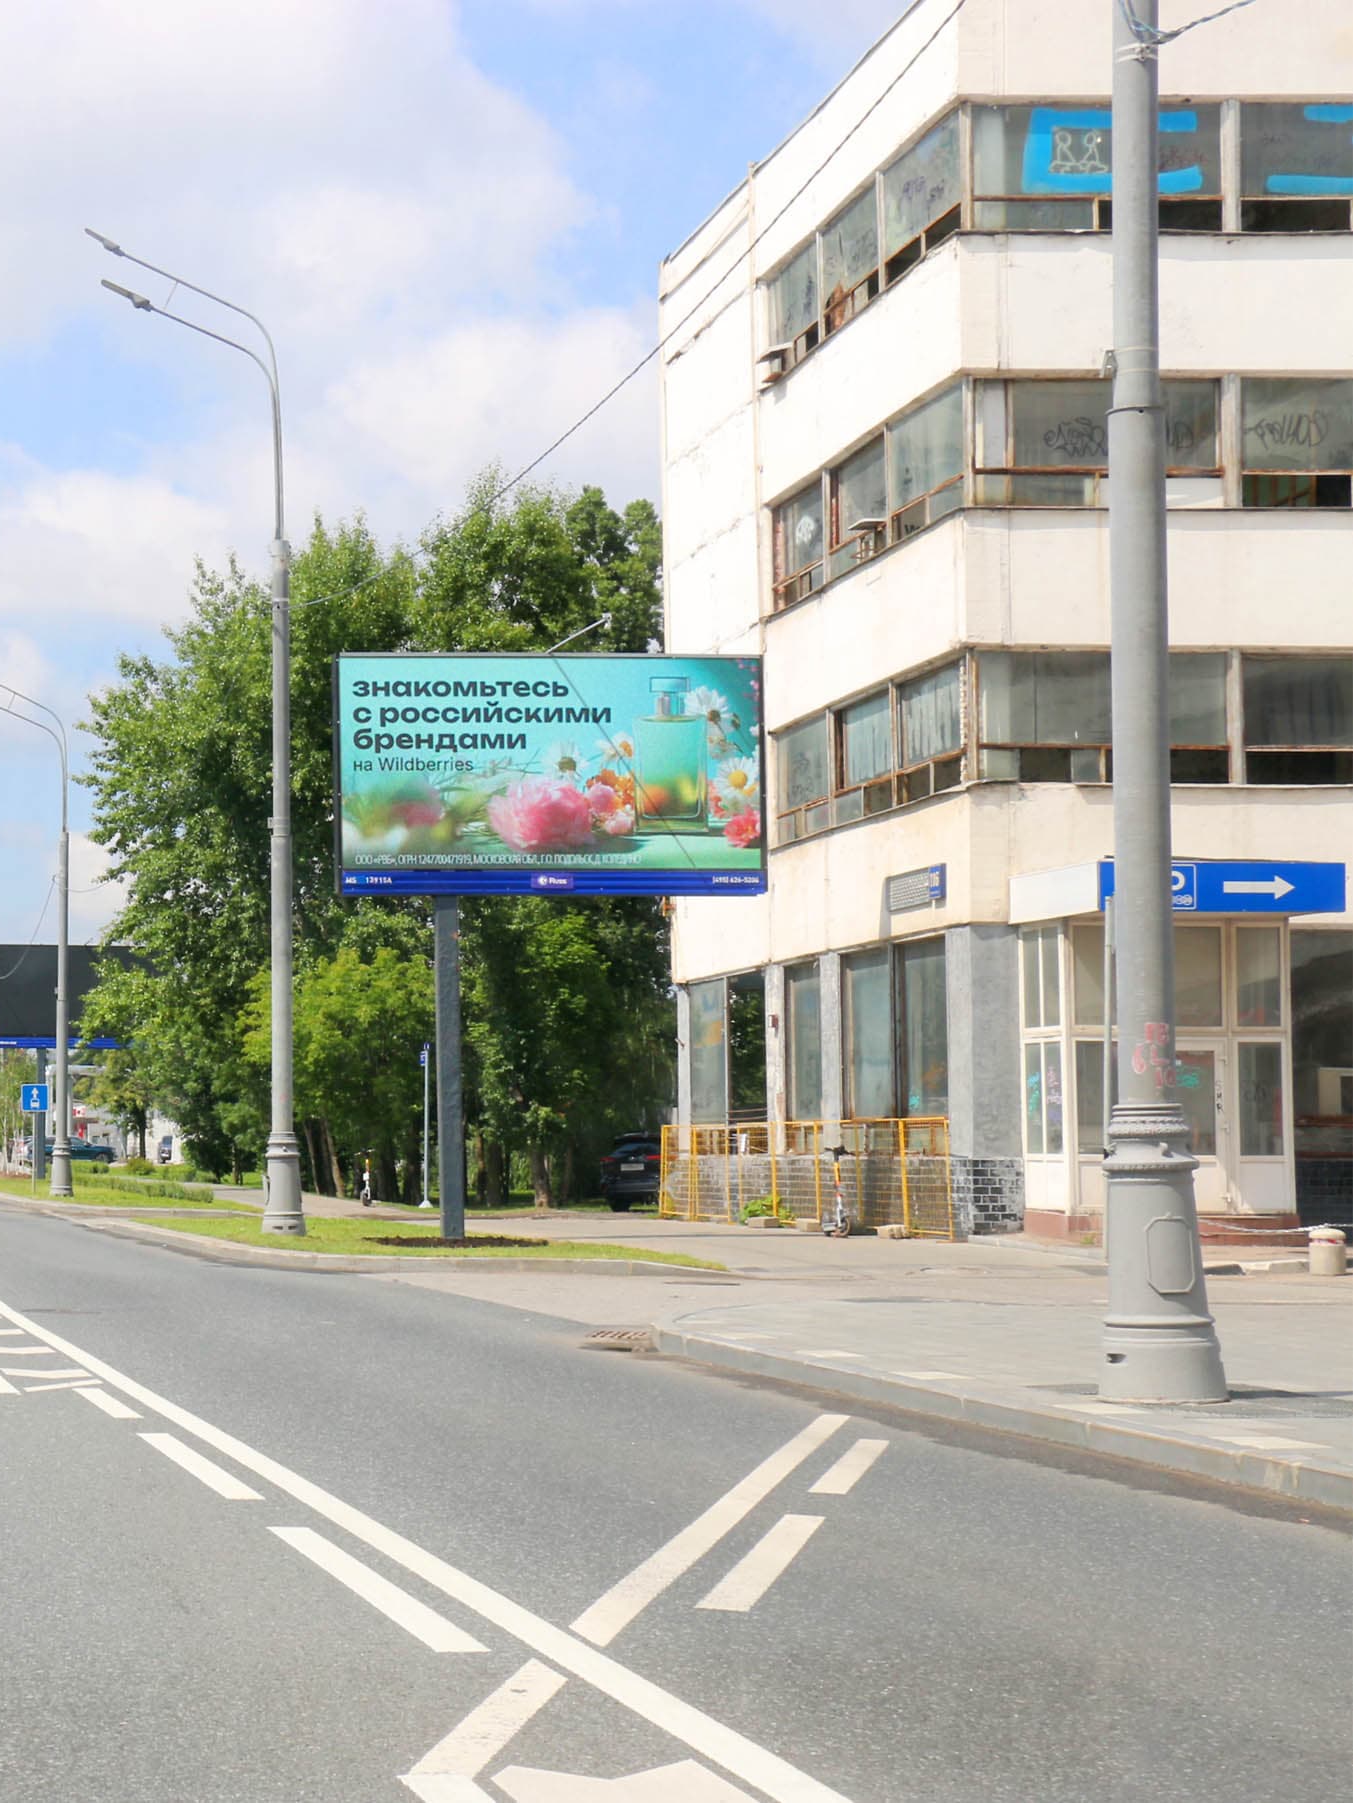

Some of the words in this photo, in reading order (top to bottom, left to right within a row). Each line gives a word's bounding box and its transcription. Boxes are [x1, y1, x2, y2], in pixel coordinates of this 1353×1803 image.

[352, 680, 569, 697] знакомьтесь
[352, 706, 372, 724] с
[379, 700, 612, 728] российскими
[352, 727, 527, 753] брендами
[352, 760, 374, 772] на
[377, 757, 474, 772] Wildberries
